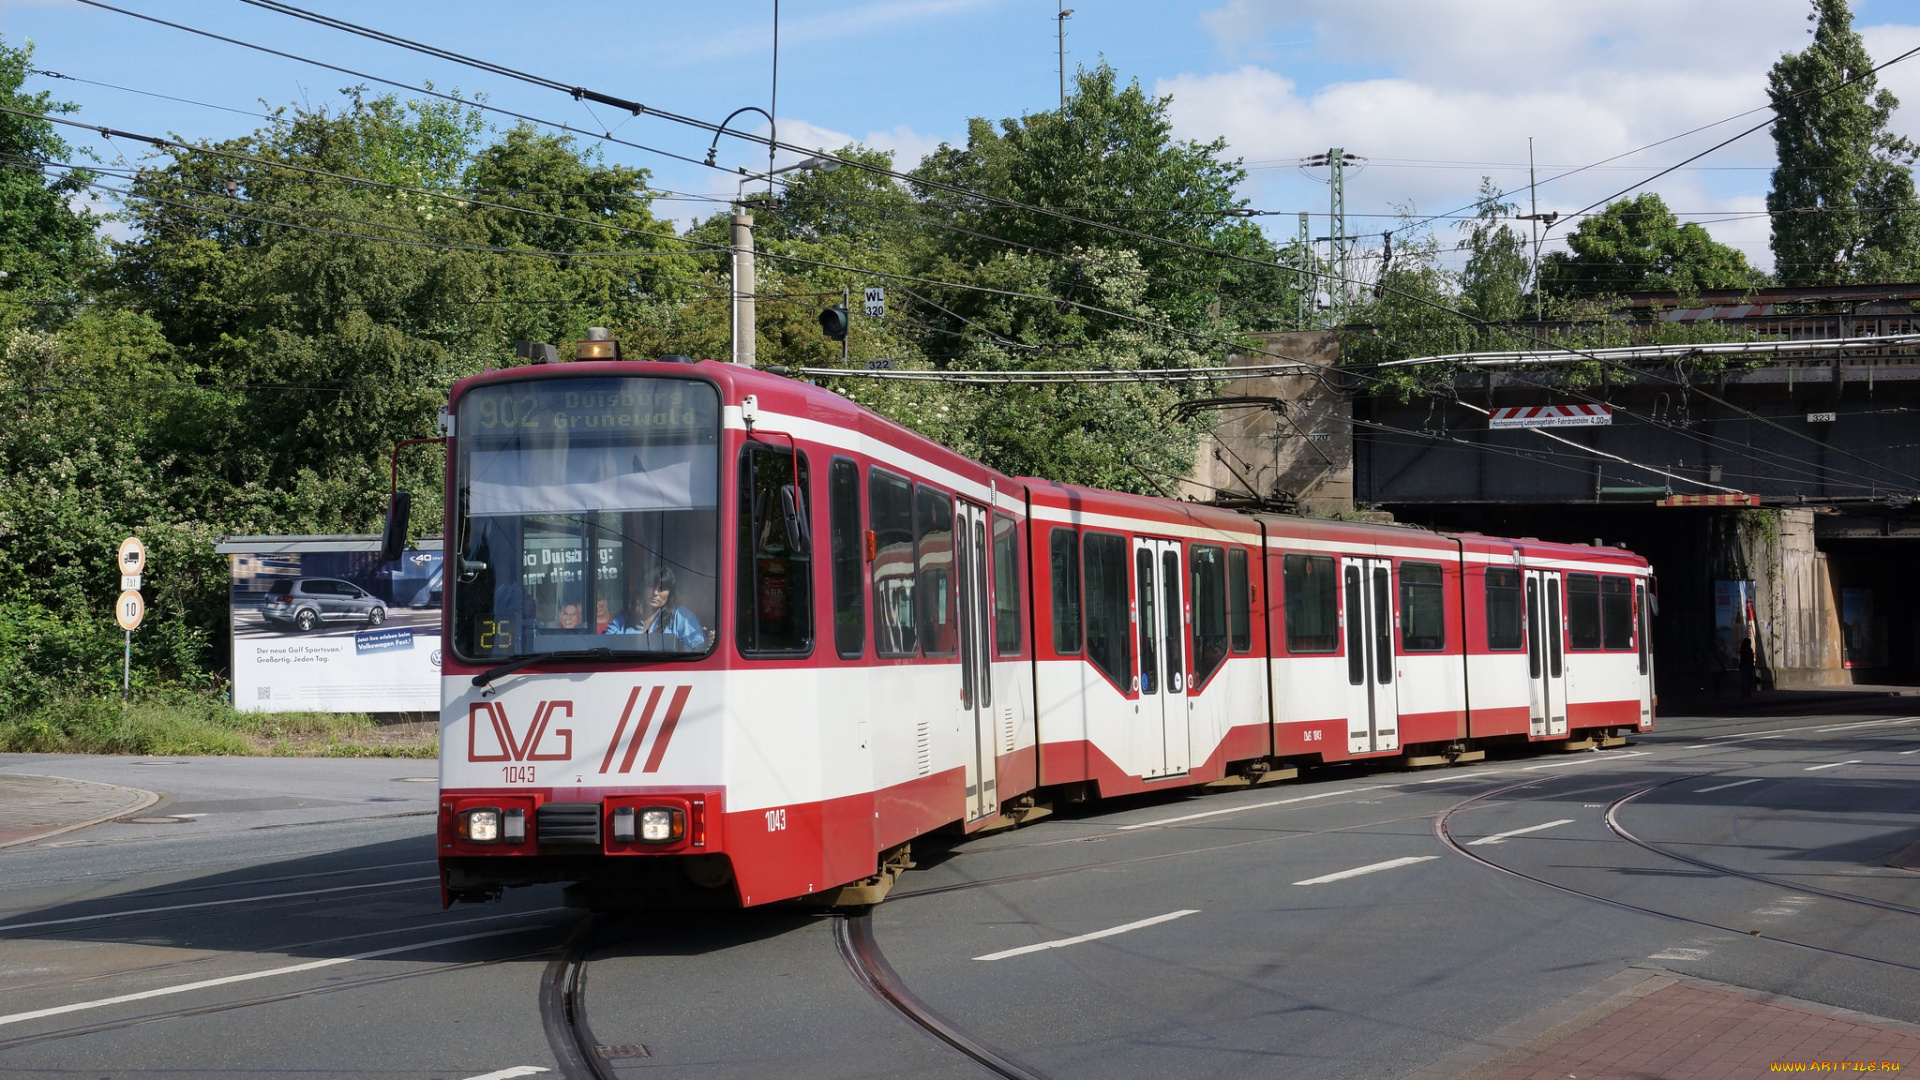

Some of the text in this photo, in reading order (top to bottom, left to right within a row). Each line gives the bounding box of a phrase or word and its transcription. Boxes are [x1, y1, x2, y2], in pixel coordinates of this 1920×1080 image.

[866, 292, 883, 301] WL
[866, 306, 883, 316] 320
[869, 361, 889, 370] 322
[480, 396, 539, 428] 902
[553, 408, 696, 429] Grunewald
[1812, 414, 1830, 422] 323
[542, 548, 613, 564] Duisbg:
[126, 602, 136, 617] 10
[480, 620, 512, 648] 25
[288, 646, 304, 654] Golf
[358, 640, 395, 650] Volkswagen
[256, 655, 330, 664] Großartig. Jeden Tag.
[468, 700, 573, 763] DVG
[502, 765, 535, 783] 1043
[765, 809, 786, 832] 1043
